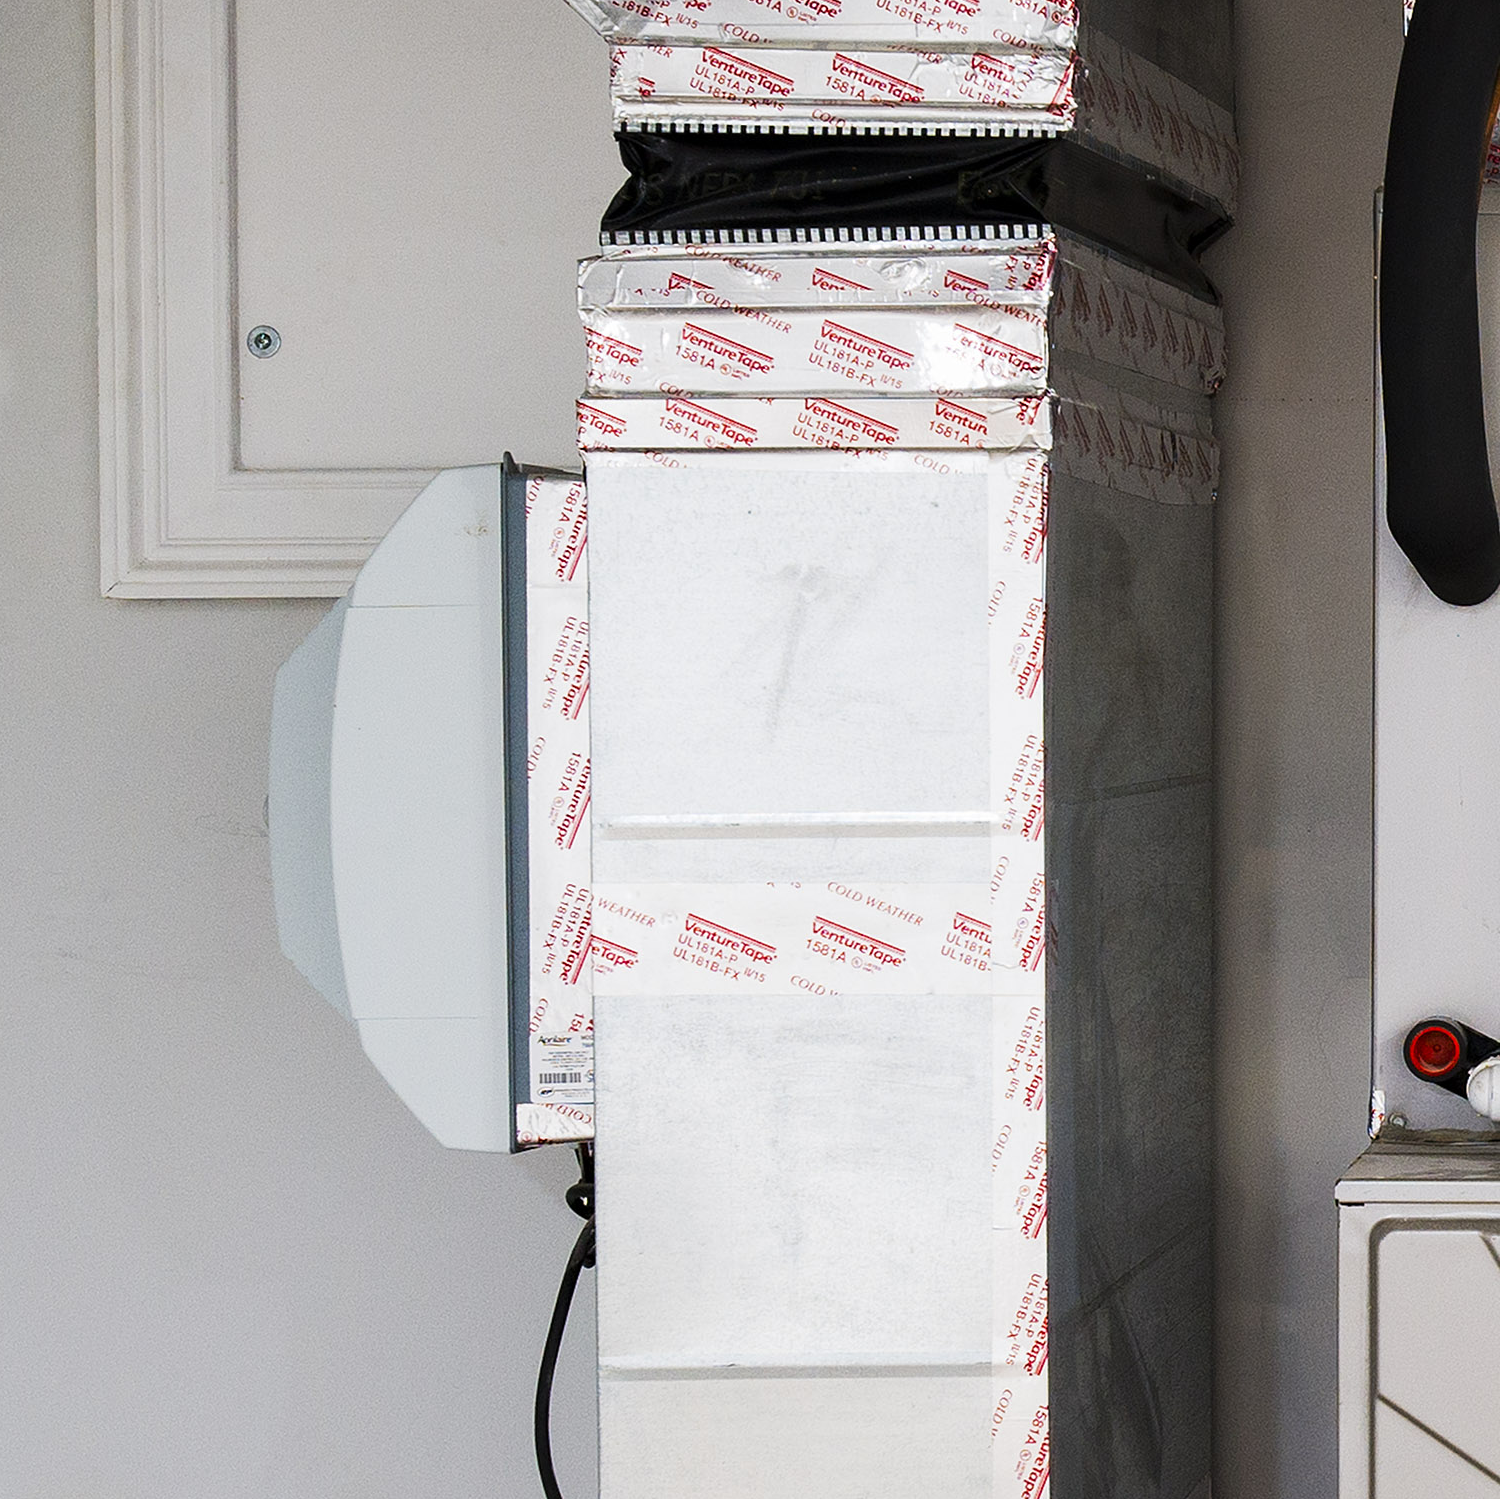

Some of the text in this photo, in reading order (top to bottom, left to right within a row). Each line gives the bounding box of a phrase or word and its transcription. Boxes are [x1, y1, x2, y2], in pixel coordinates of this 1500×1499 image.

[696, 290, 792, 333] COLD WEATHER
[675, 345, 715, 370] 1581A
[808, 353, 877, 387] UL181B-FX
[813, 340, 875, 370] UL181A-P
[665, 399, 758, 446] VentureTape
[804, 399, 899, 445] VentureTape
[827, 881, 924, 926] COLD WEATHER
